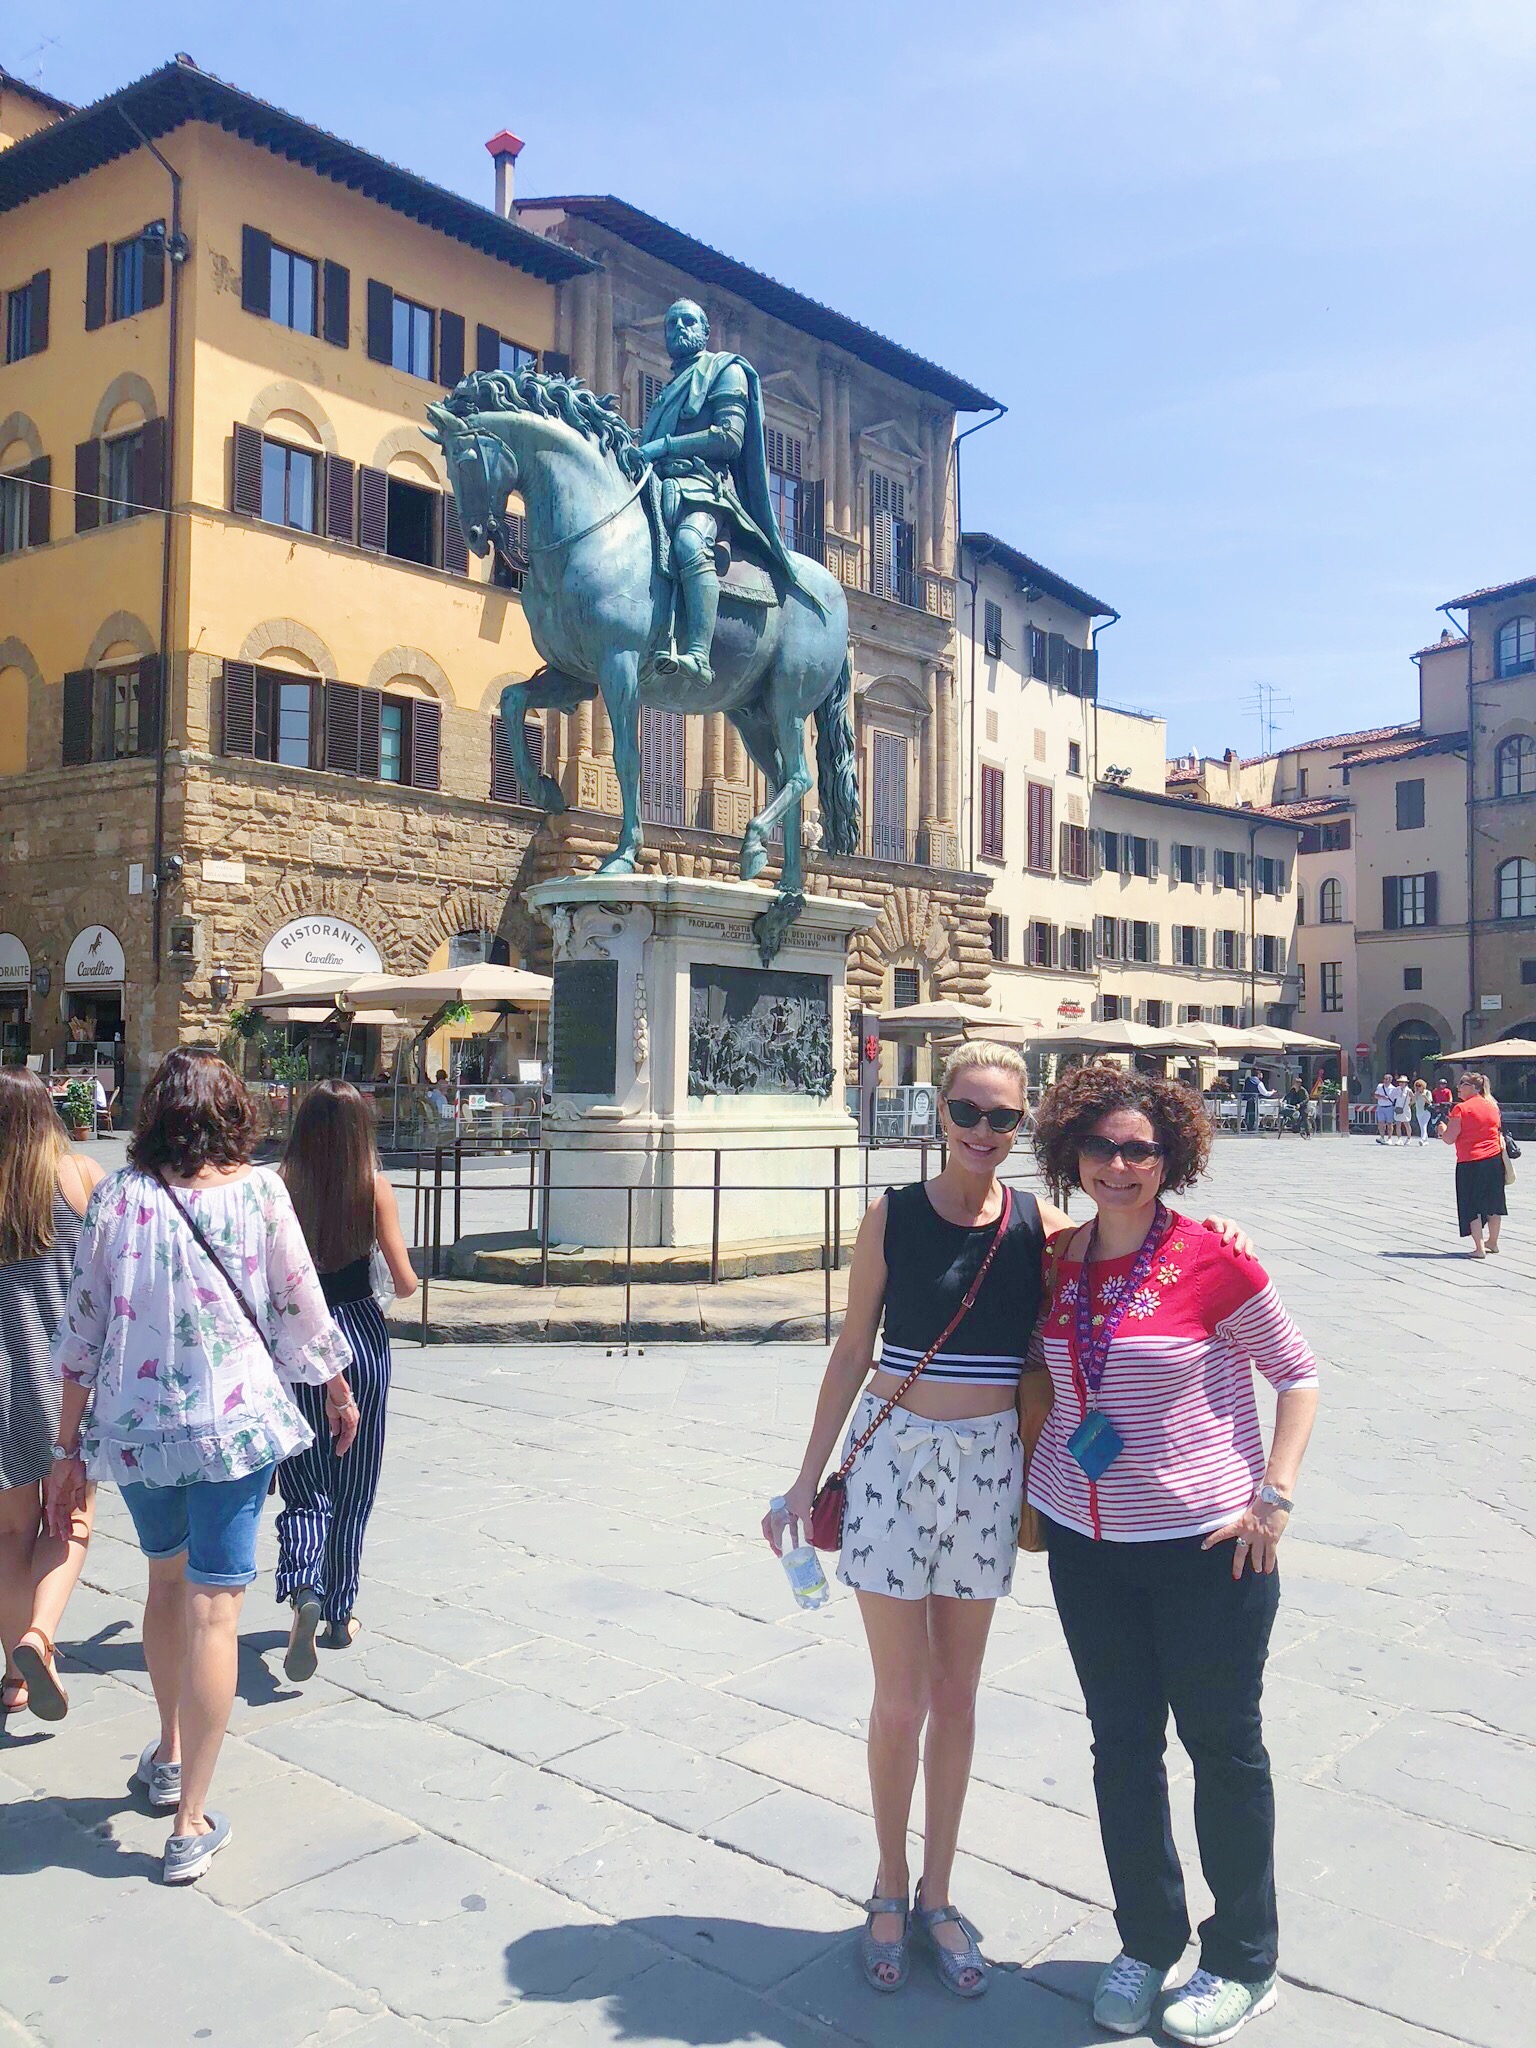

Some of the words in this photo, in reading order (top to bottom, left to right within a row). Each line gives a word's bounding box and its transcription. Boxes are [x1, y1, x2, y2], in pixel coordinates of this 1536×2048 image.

[280, 924, 366, 955] RISTORANTE
[721, 931, 751, 940] ACCEPTIS
[791, 930, 836, 942] DEDITIONEM
[305, 951, 344, 966] Cavallino
[77, 960, 115, 977] Cavallino
